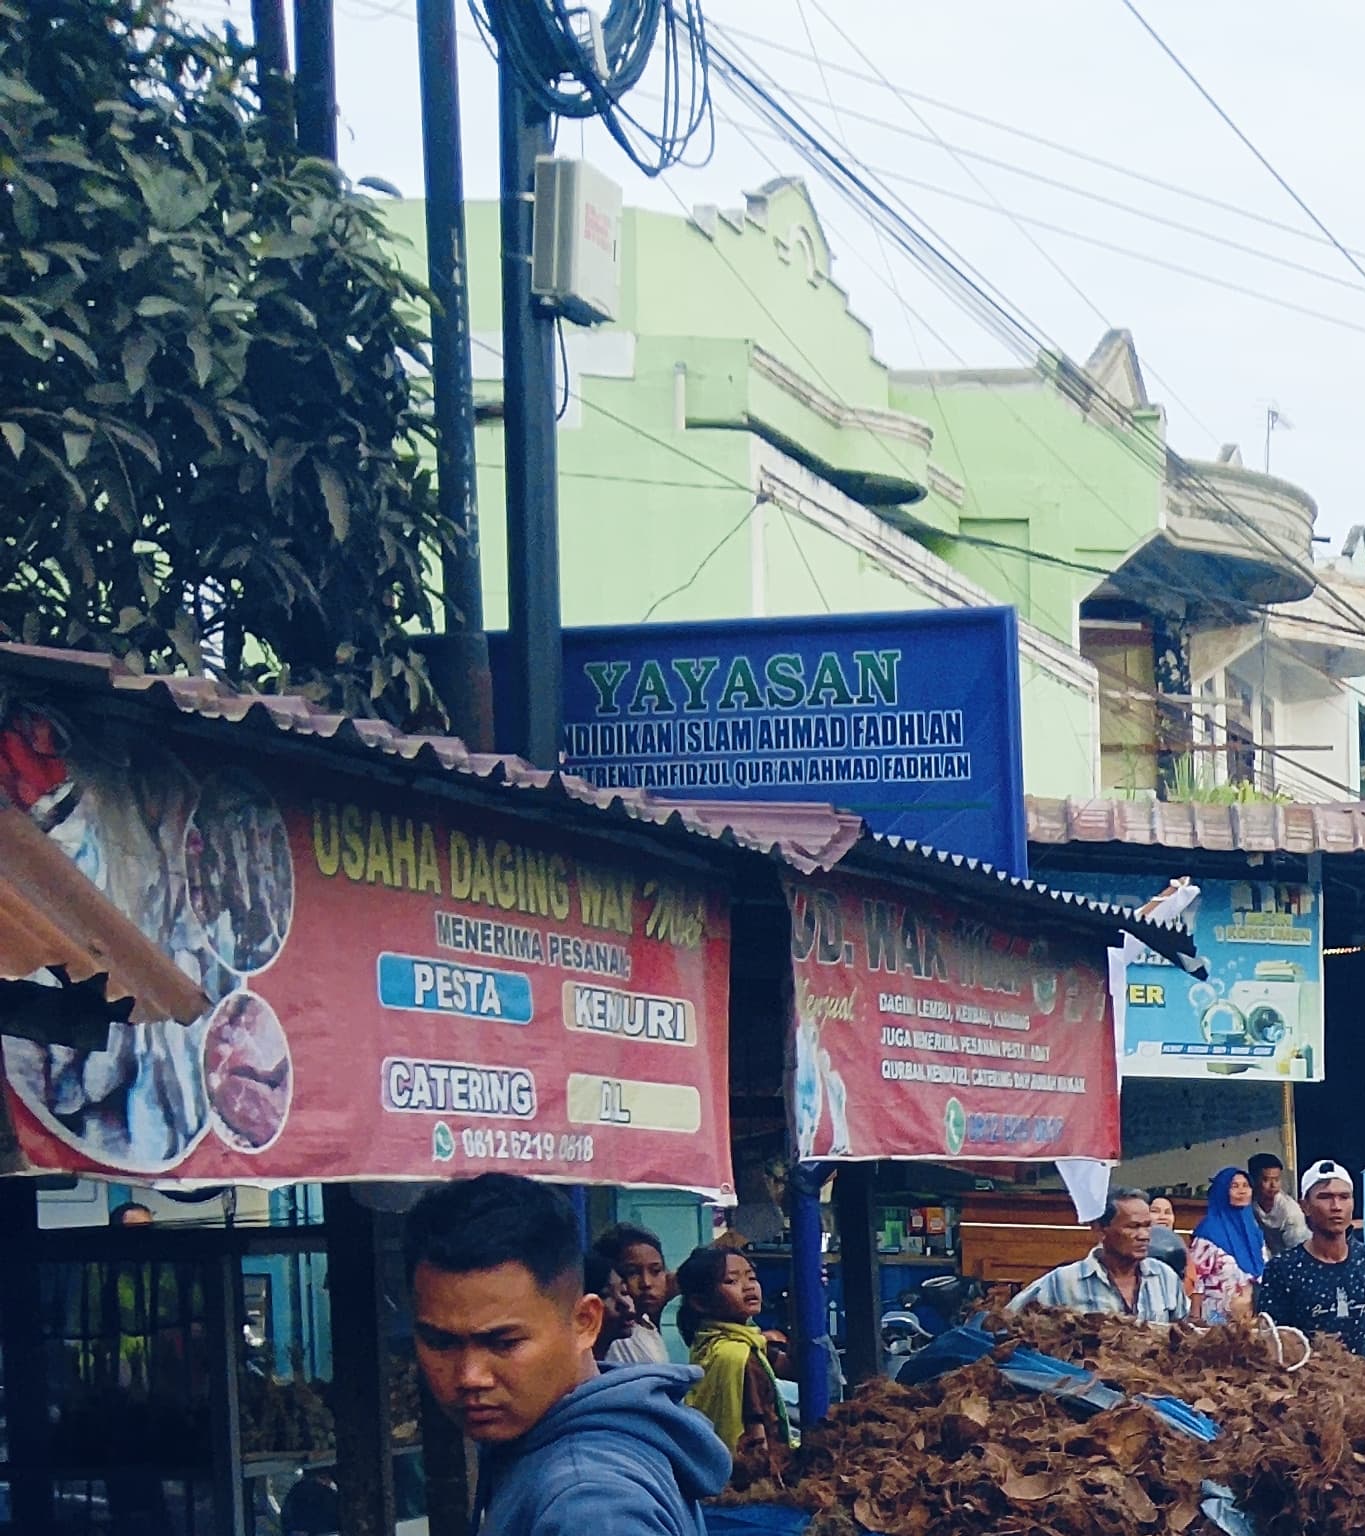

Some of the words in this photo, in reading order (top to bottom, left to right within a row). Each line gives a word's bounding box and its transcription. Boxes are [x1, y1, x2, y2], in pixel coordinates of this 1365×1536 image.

[585, 650, 903, 716] YAYASAN
[677, 716, 754, 756] ISLAM
[757, 713, 848, 753] AHMAD
[852, 709, 964, 749] FADHLAN
[632, 759, 732, 790] TAHFIDZUL
[805, 755, 879, 785] AHMAD
[882, 751, 971, 782] FADHLAN
[312, 802, 442, 895] USAHA
[449, 828, 570, 921] DAGING
[434, 910, 544, 965] MENERIMA
[1226, 925, 1312, 946] KONSUMEN
[412, 962, 502, 1016] PESTA
[1127, 982, 1166, 1008] ER
[880, 1026, 913, 1048] JUGA
[388, 1061, 534, 1116] CATERING
[462, 1127, 509, 1159] 0812
[510, 1129, 555, 1162] 6219
